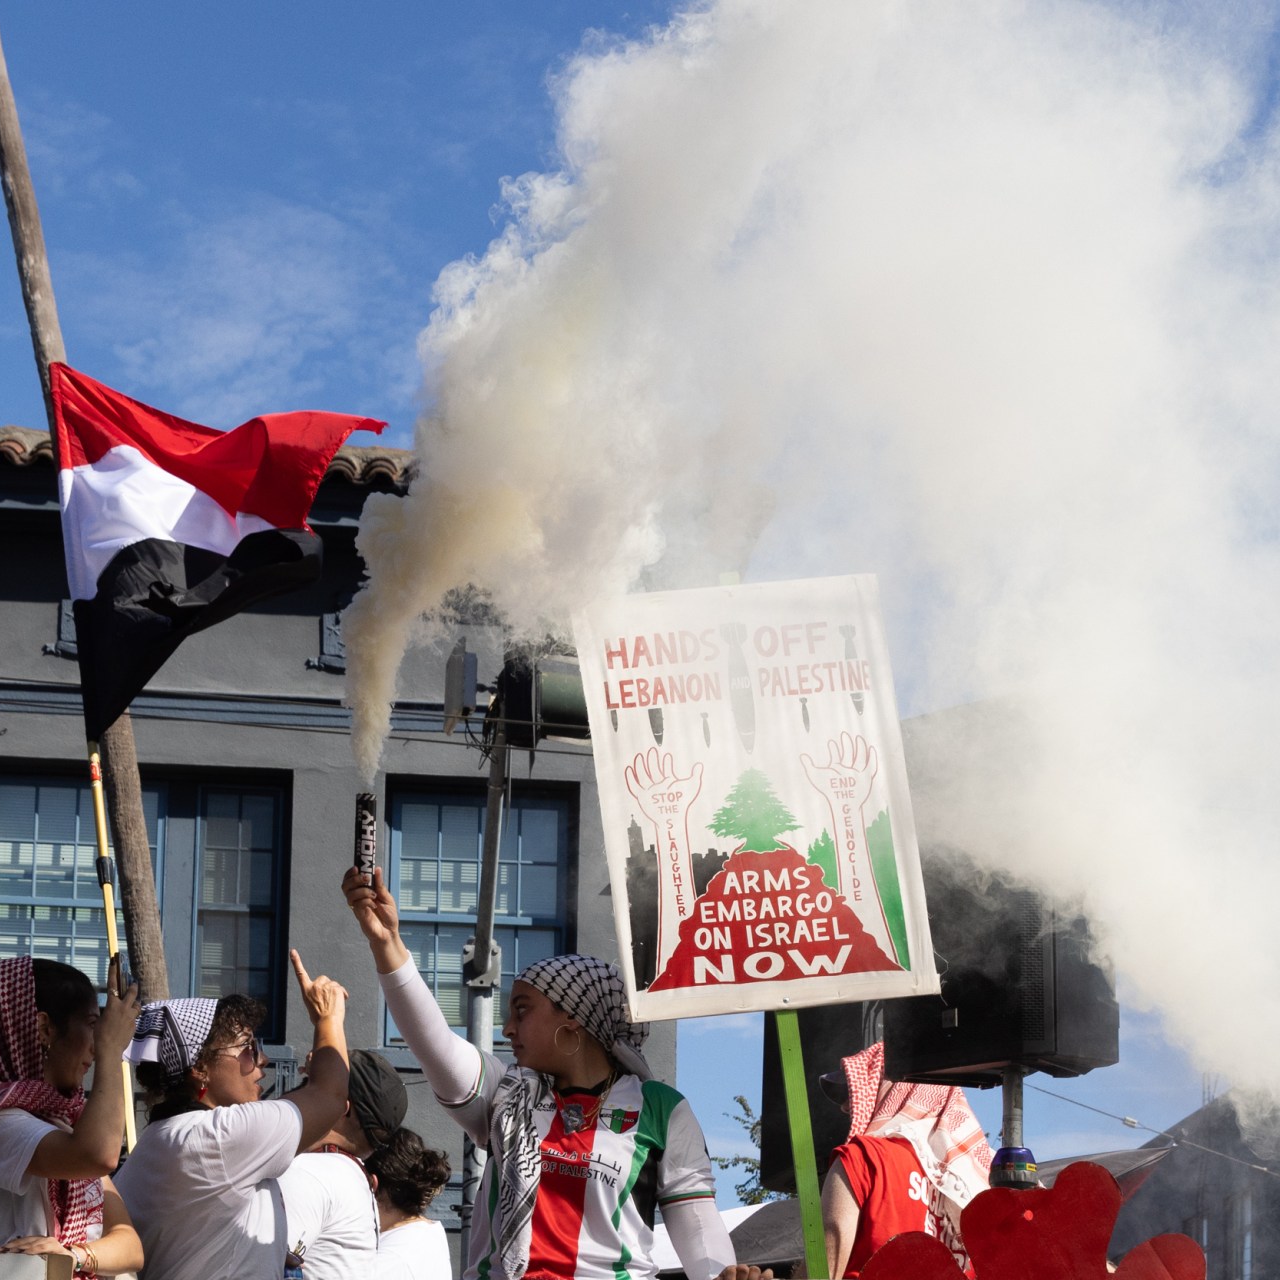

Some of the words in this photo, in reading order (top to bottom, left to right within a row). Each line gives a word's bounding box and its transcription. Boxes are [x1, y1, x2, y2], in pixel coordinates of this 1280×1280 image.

[603, 628, 719, 670] HANDS
[753, 621, 828, 658] OFF
[603, 672, 722, 710] LEBANON
[730, 676, 751, 690] AND
[758, 660, 872, 698] PALESTINE
[830, 776, 856, 790] END
[833, 788, 854, 799] THE
[651, 791, 683, 805] STOP
[658, 804, 679, 814] THE
[723, 866, 811, 895] ARMS
[701, 892, 833, 924] EMBARGO
[694, 926, 732, 951] ON
[746, 916, 850, 947] ISRAEL
[694, 944, 853, 985] NOW
[541, 1161, 557, 1173] OF
[560, 1163, 618, 1188] PALESTINE
